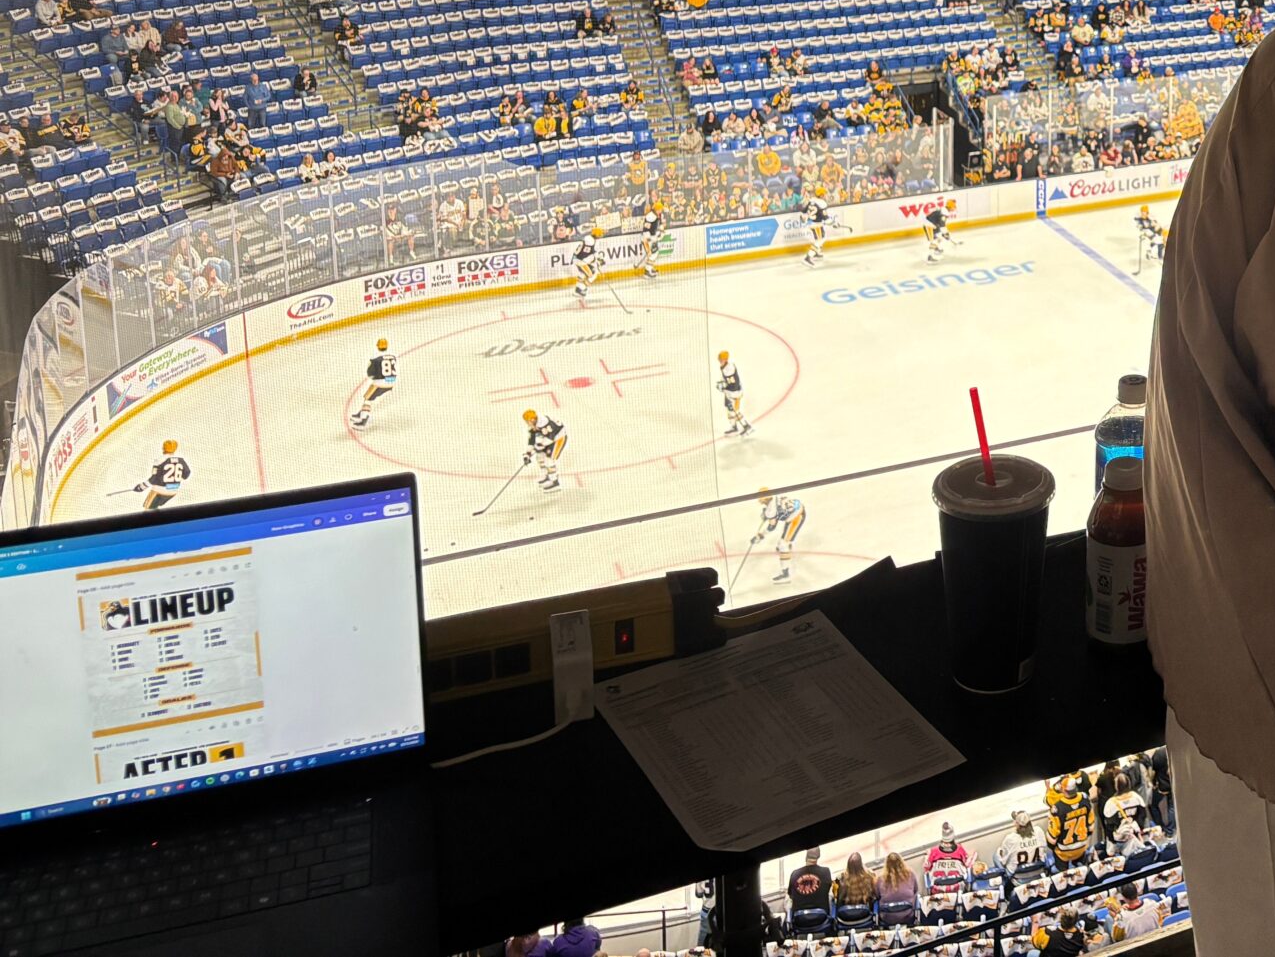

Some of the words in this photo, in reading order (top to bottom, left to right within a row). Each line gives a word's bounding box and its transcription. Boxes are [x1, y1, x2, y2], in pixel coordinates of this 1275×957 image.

[1069, 179, 1116, 199] Coors
[1118, 175, 1161, 191] LIGHT
[709, 225, 749, 236] Homegrown
[709, 234, 730, 243] health
[730, 230, 761, 241] insurance
[606, 244, 643, 261] WIN!
[710, 243, 724, 251] that
[724, 241, 746, 250] scores.
[457, 257, 491, 275] FOX
[492, 253, 518, 270] 56
[364, 272, 398, 293] FOX
[397, 267, 426, 285] 56
[431, 280, 452, 288] NEWS
[458, 280, 487, 290] FIRST
[821, 260, 1036, 305] Geisinger
[295, 295, 326, 316] AHL
[365, 296, 394, 308] FIRST
[475, 327, 642, 358] Wegmans
[120, 368, 138, 384] Your
[138, 347, 175, 374] Gateway
[138, 371, 147, 382] to
[147, 344, 200, 377] Everywhere.
[163, 463, 184, 483] 26
[131, 586, 236, 627] LINEUP
[1063, 814, 1089, 846] 74
